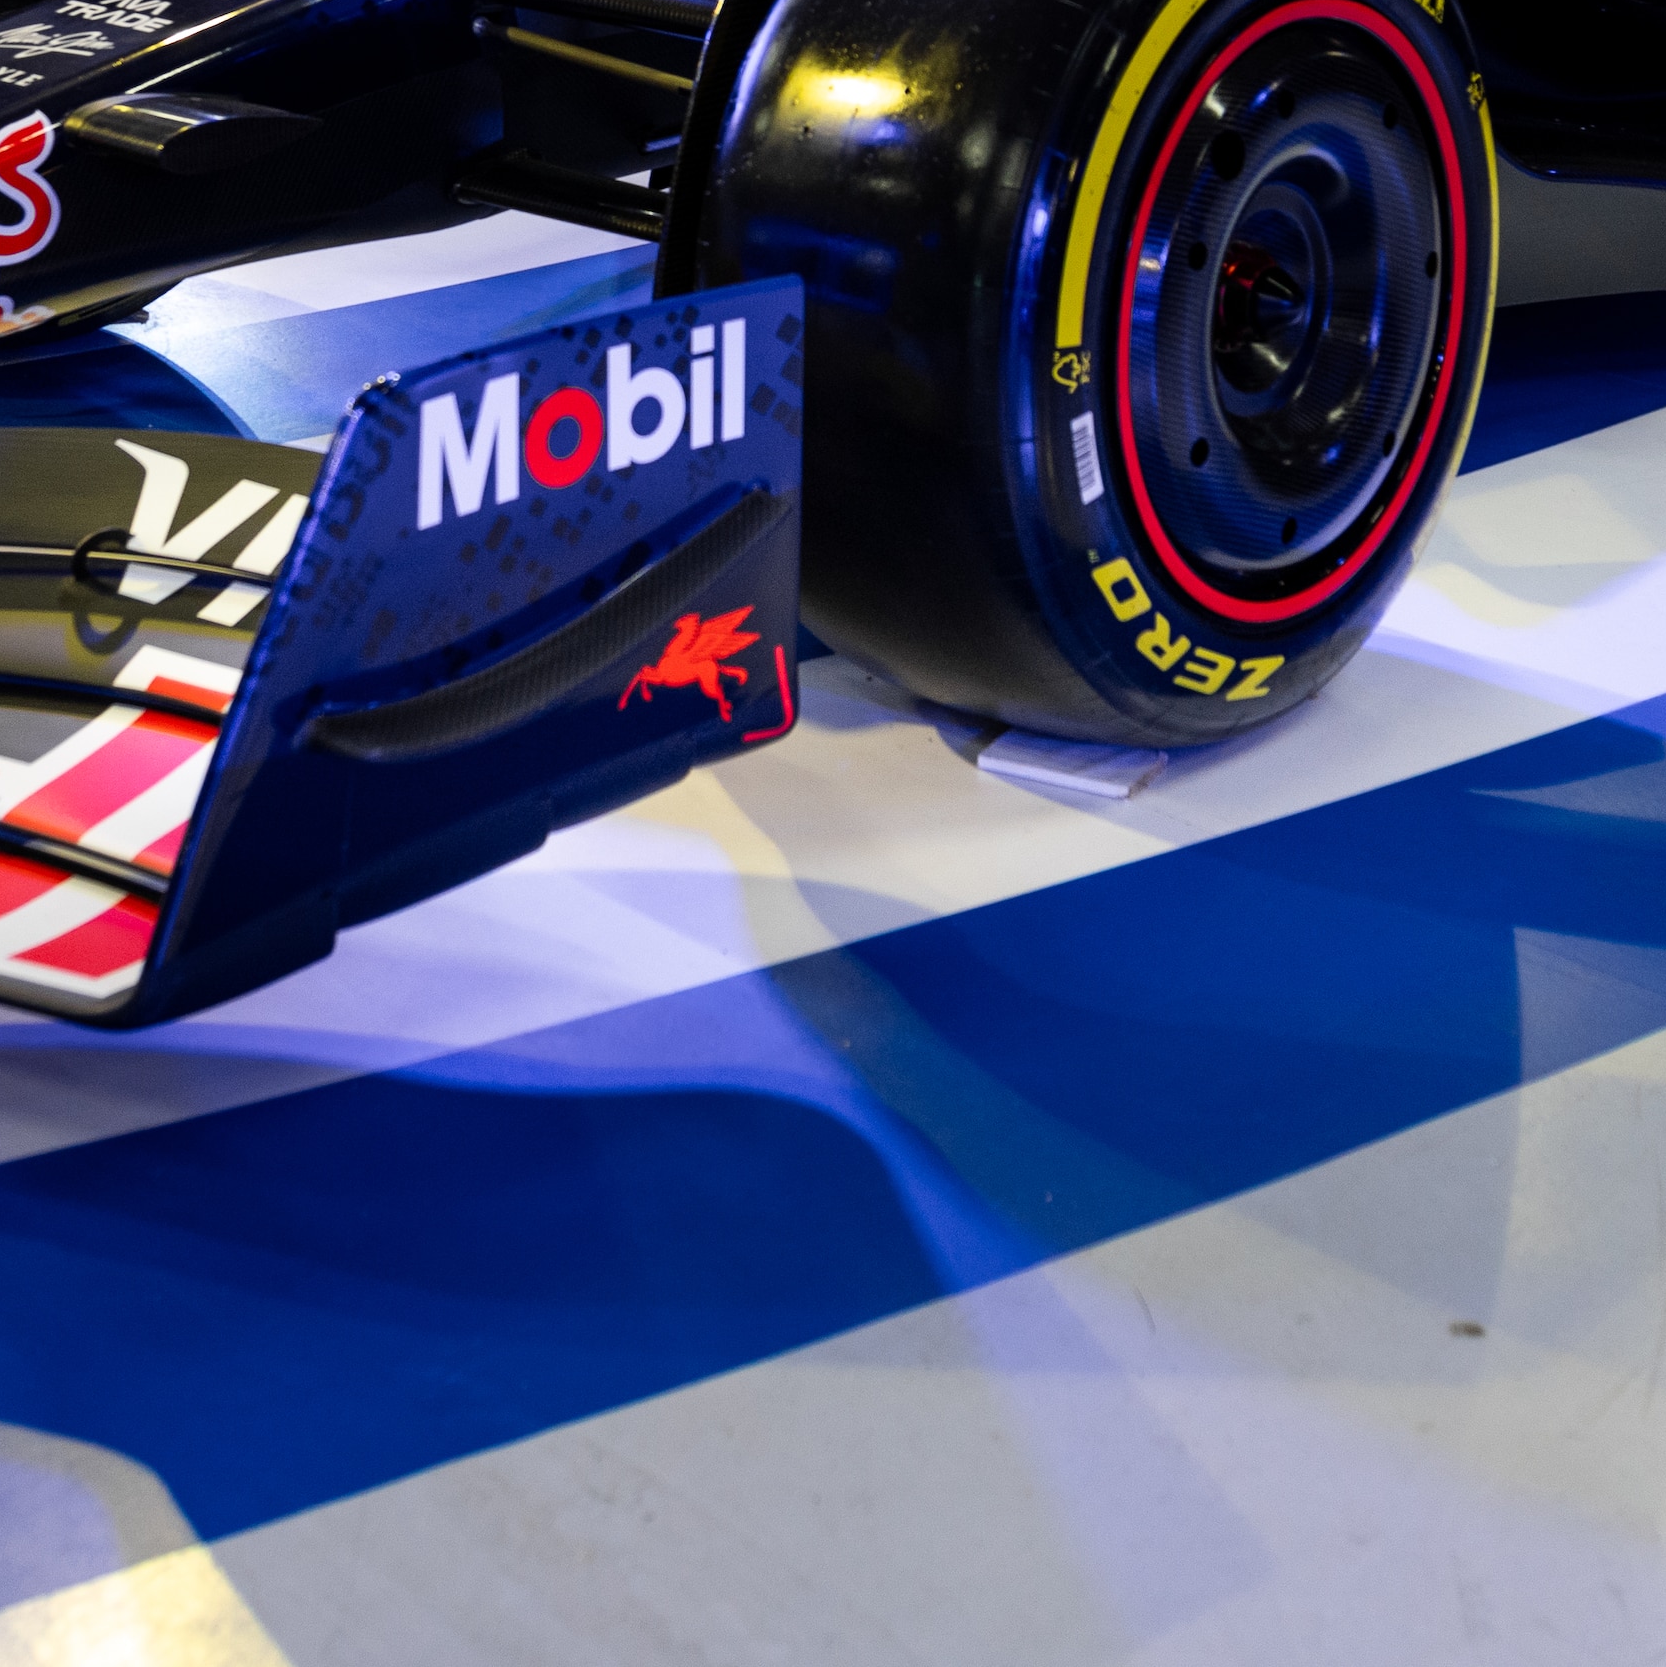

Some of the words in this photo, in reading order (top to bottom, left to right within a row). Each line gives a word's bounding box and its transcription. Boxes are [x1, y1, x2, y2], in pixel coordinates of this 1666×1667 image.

[55, 0, 175, 34] TRADE
[416, 317, 748, 531] Mobil
[1089, 555, 1286, 702] ZERO
